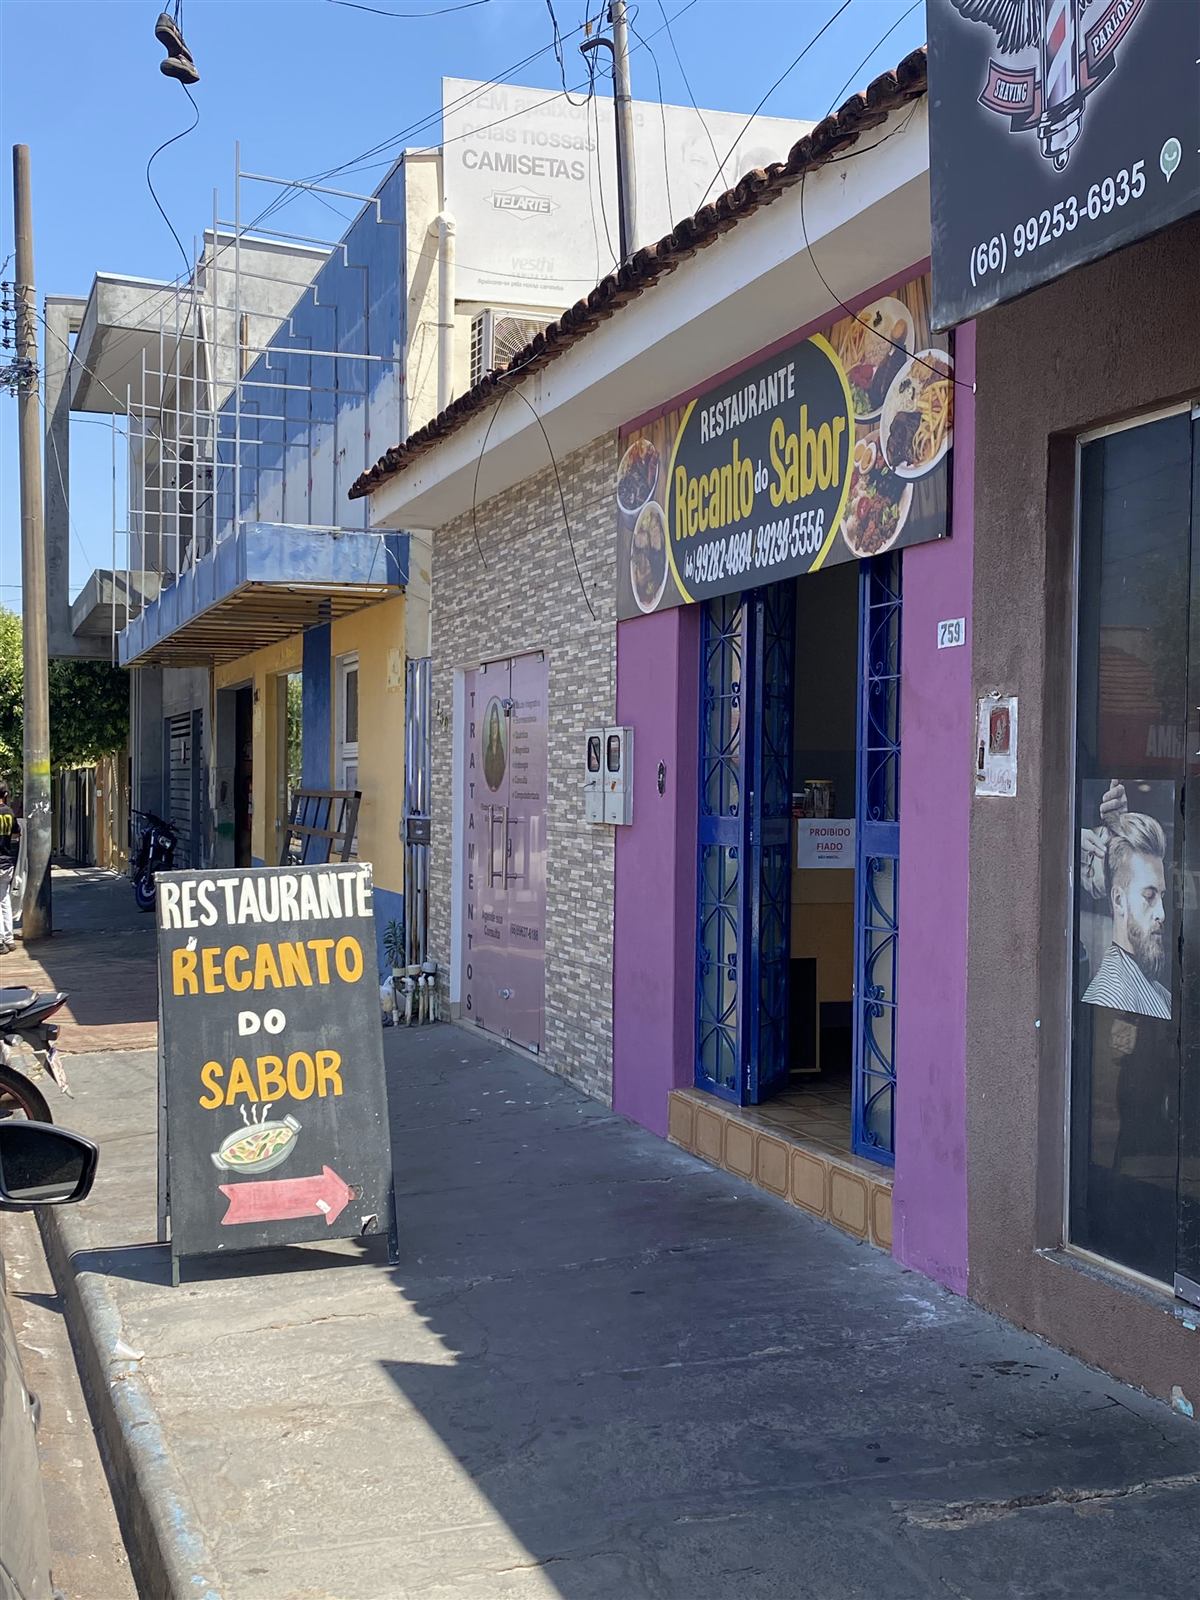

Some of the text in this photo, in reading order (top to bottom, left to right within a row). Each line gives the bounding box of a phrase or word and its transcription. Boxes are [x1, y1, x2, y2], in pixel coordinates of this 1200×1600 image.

[993, 79, 1028, 104] SHAVING
[462, 121, 596, 152] pelas nossas
[462, 149, 586, 181] CAMISETAS
[969, 160, 1146, 287] (66) 99253-6935
[700, 362, 795, 444] RESTAURANTE
[675, 404, 845, 540] Recanto do Sabor
[940, 621, 961, 646] 759
[809, 828, 851, 837] PROIBIDO
[816, 842, 843, 851] FIADO
[160, 870, 374, 929] RESTAURANTE
[172, 936, 364, 996] RECANTO
[238, 1008, 286, 1036] DO
[199, 1049, 343, 1110] SABOR
